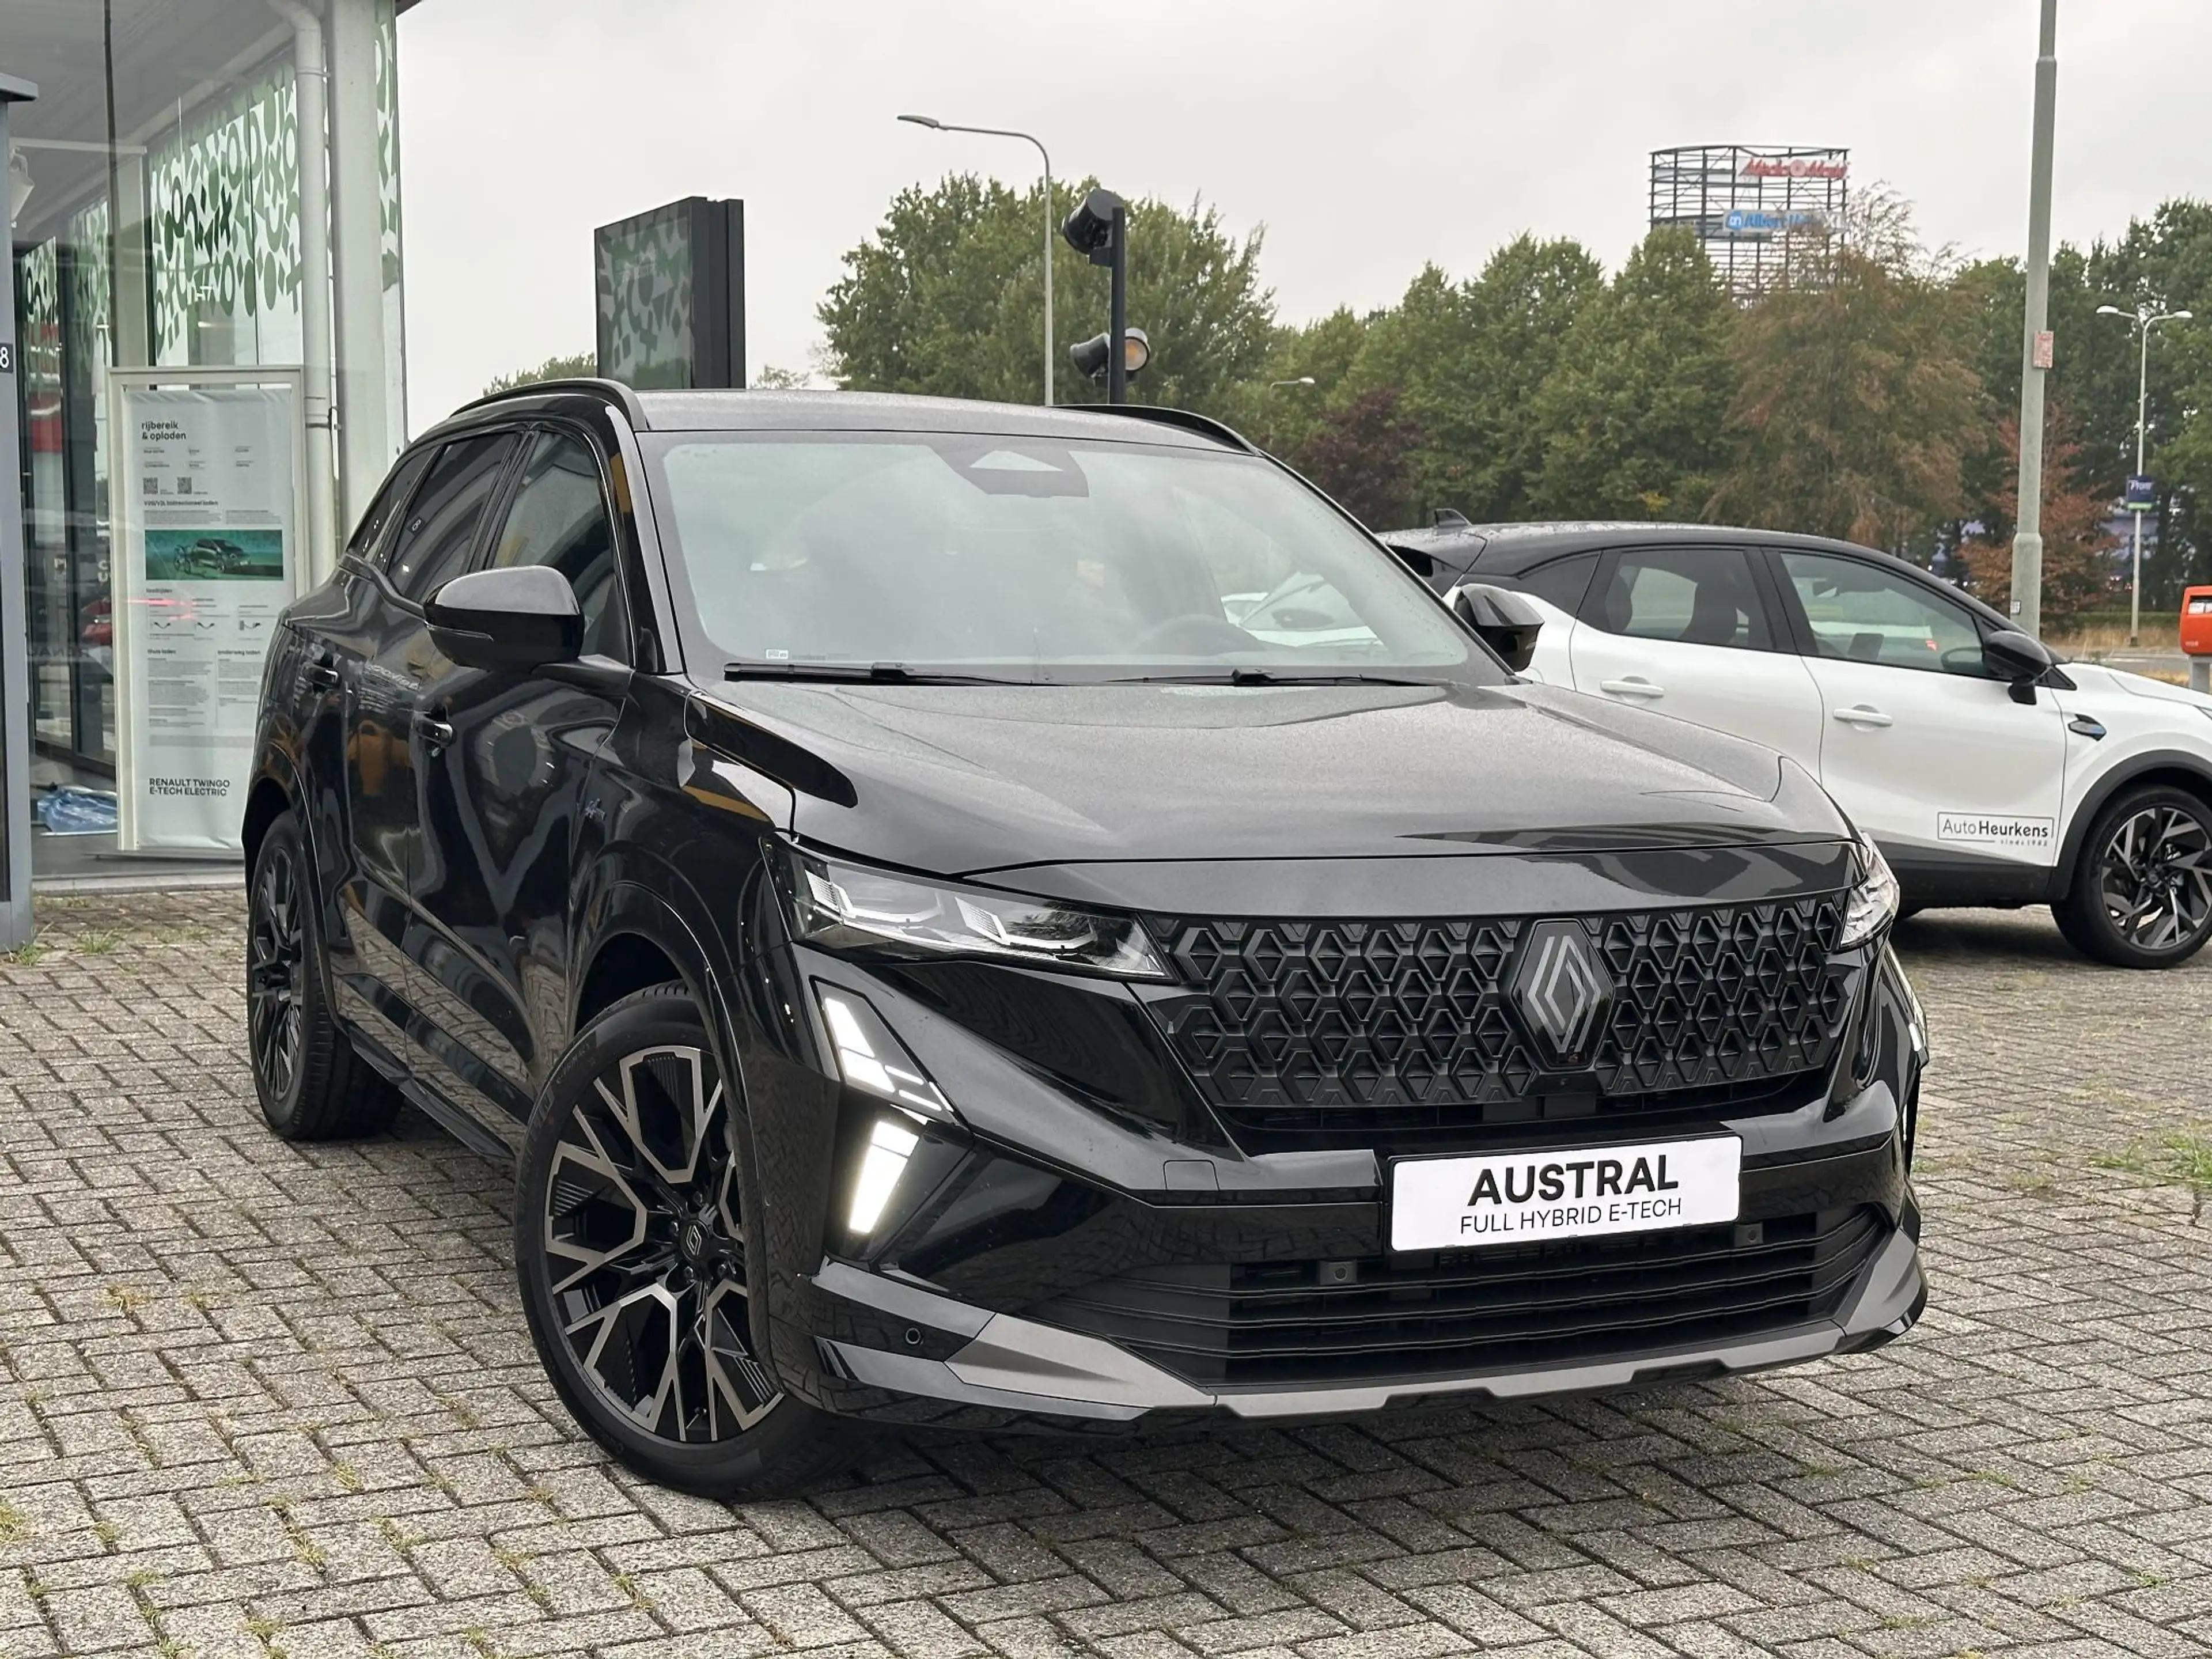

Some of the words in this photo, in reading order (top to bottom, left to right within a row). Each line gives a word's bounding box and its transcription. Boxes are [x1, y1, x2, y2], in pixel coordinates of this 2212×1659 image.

[141, 420, 179, 431] rijbereik
[149, 778, 192, 786] RENAULT
[192, 779, 230, 787] TWINGO
[149, 786, 183, 796] E-TECH
[184, 787, 227, 797] ELECTRIC
[1467, 1154, 1679, 1206] AUSTRAL
[1461, 1213, 1514, 1234] FULL
[1520, 1205, 1602, 1230] HYBRID
[1609, 1197, 1682, 1222] E-TECH
